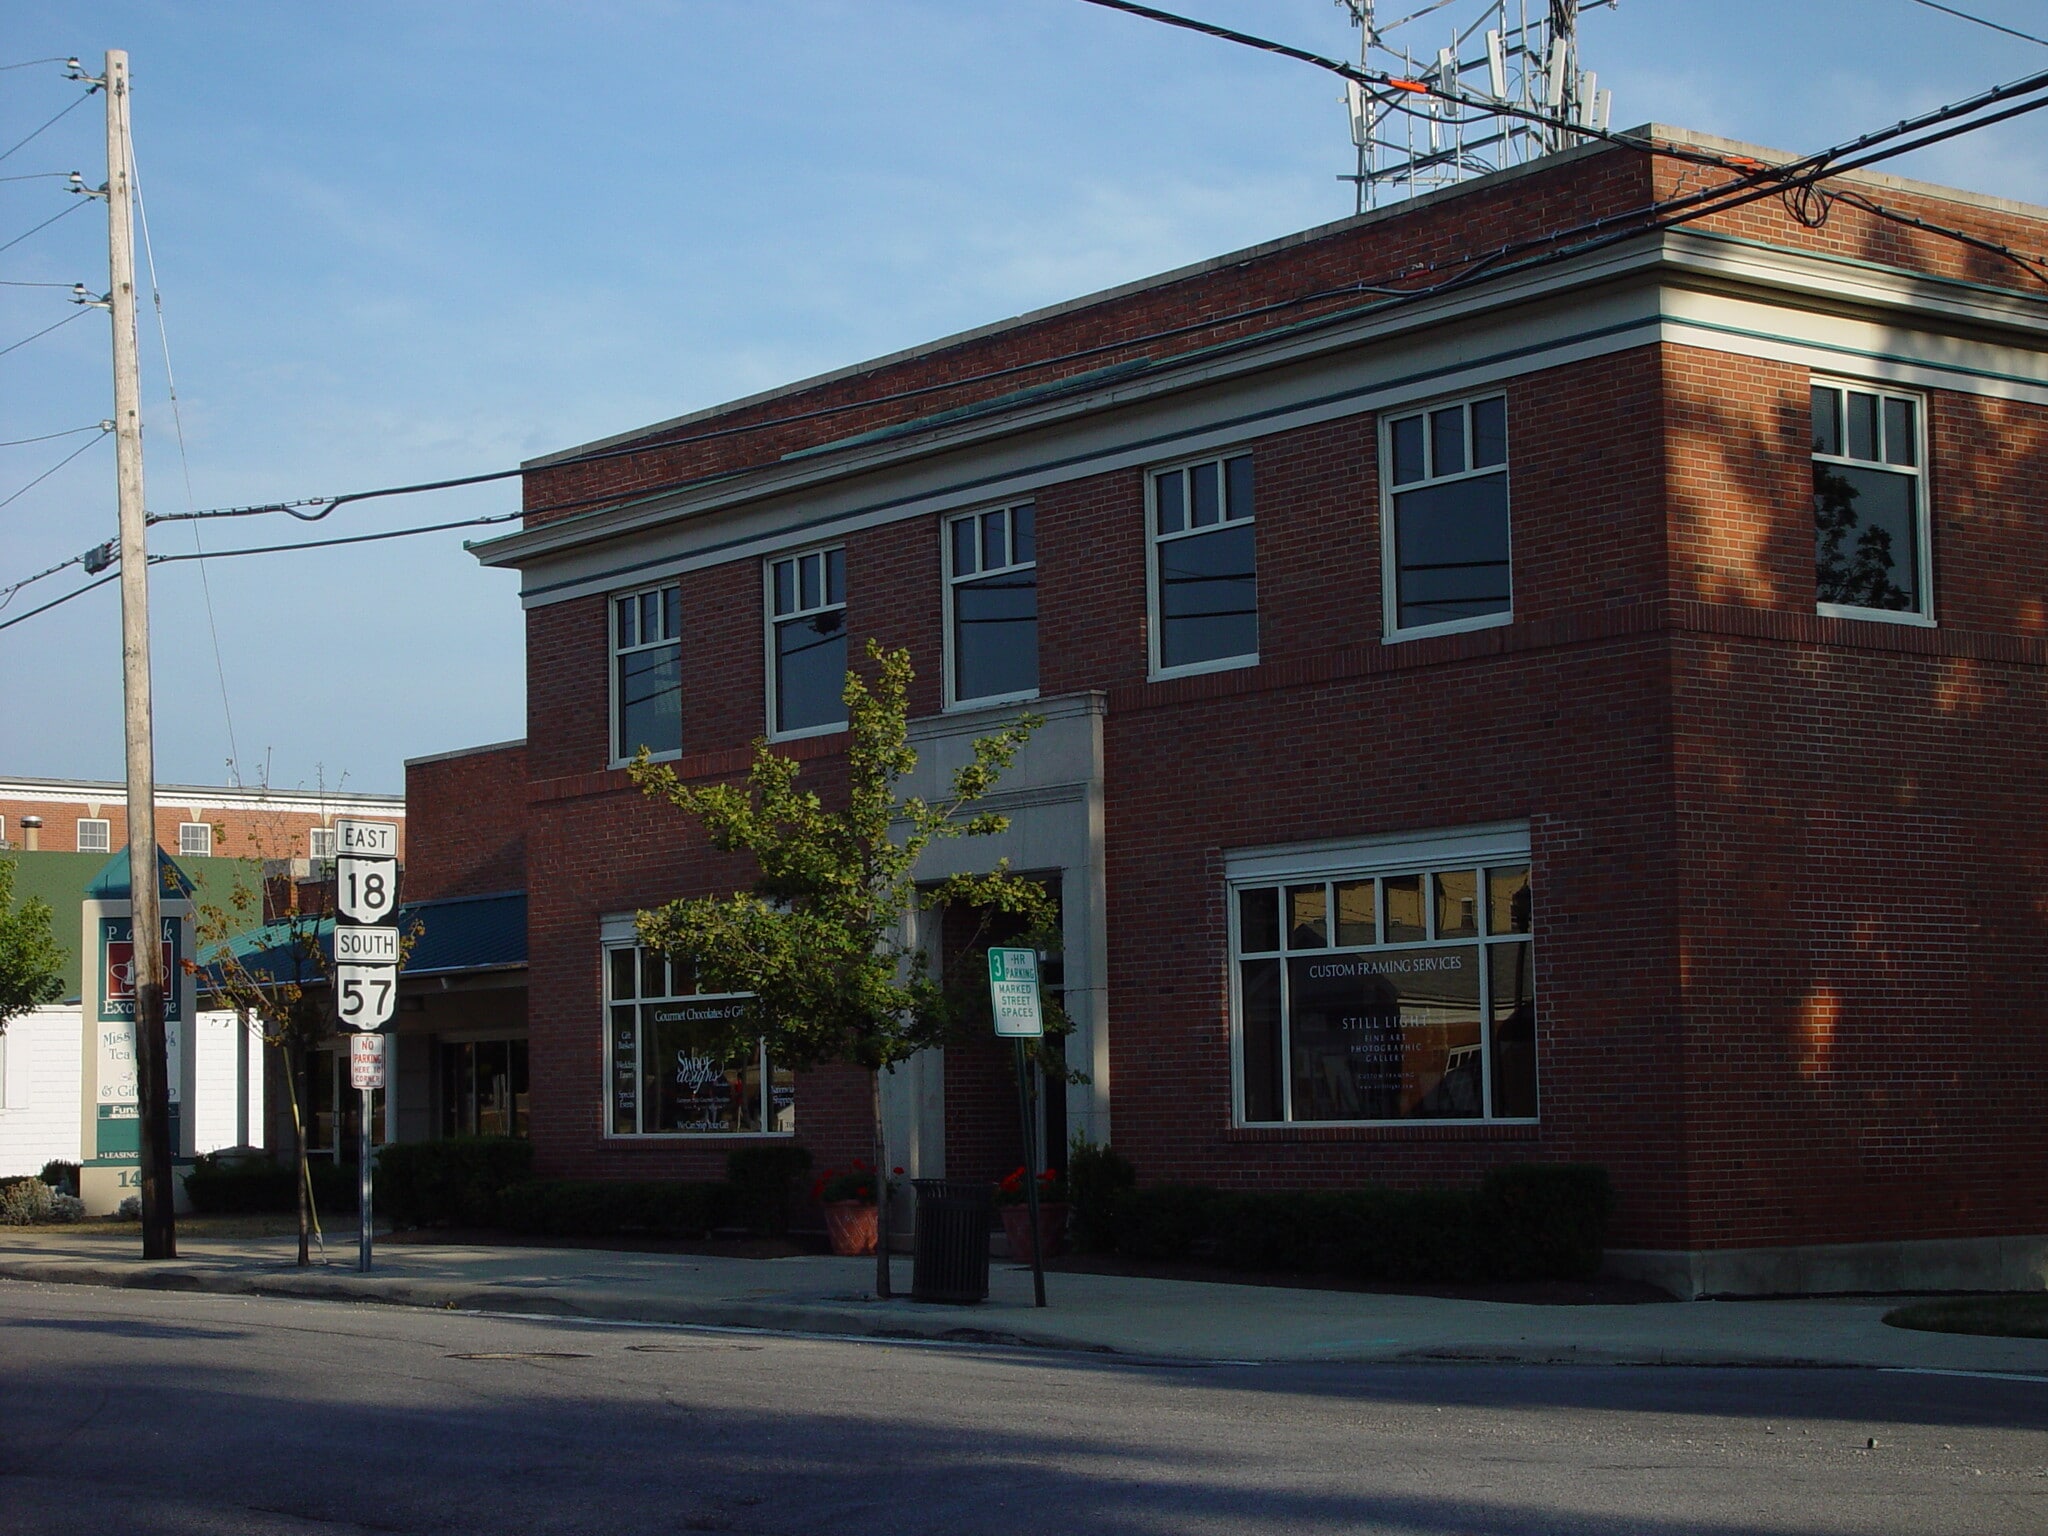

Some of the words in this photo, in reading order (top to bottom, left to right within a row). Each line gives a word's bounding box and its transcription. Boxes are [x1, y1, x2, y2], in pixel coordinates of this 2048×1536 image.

[345, 827, 388, 849] EAST
[348, 872, 386, 909] 18
[106, 918, 174, 941] Pak
[340, 934, 394, 954] SOUTH
[993, 955, 1002, 977] 3
[1309, 964, 1355, 979] CUSTOM
[1358, 959, 1411, 976] FRAMING
[1413, 955, 1463, 972] SERVICES
[1005, 967, 1035, 979] PARKING
[999, 984, 1032, 994] MARKED
[342, 979, 392, 1016] 57
[1002, 996, 1031, 1006] STREET
[655, 1010, 686, 1023] Gourmet
[686, 1006, 723, 1020] Chocolates
[1002, 1008, 1034, 1018] SPACES
[1342, 1017, 1380, 1030] STILL
[1385, 1014, 1428, 1029] LIGHT
[103, 1032, 131, 1048] Miss
[361, 1040, 375, 1051] NO
[109, 1048, 130, 1060] Tea
[1350, 1043, 1423, 1053] PHOTOGRAPHIC
[353, 1054, 382, 1064] PARKING
[1365, 1055, 1406, 1063] GALLERY
[354, 1066, 370, 1074] HERE
[355, 1075, 381, 1083] CORNER
[101, 1085, 113, 1097] &
[104, 1151, 139, 1159] LEASING
